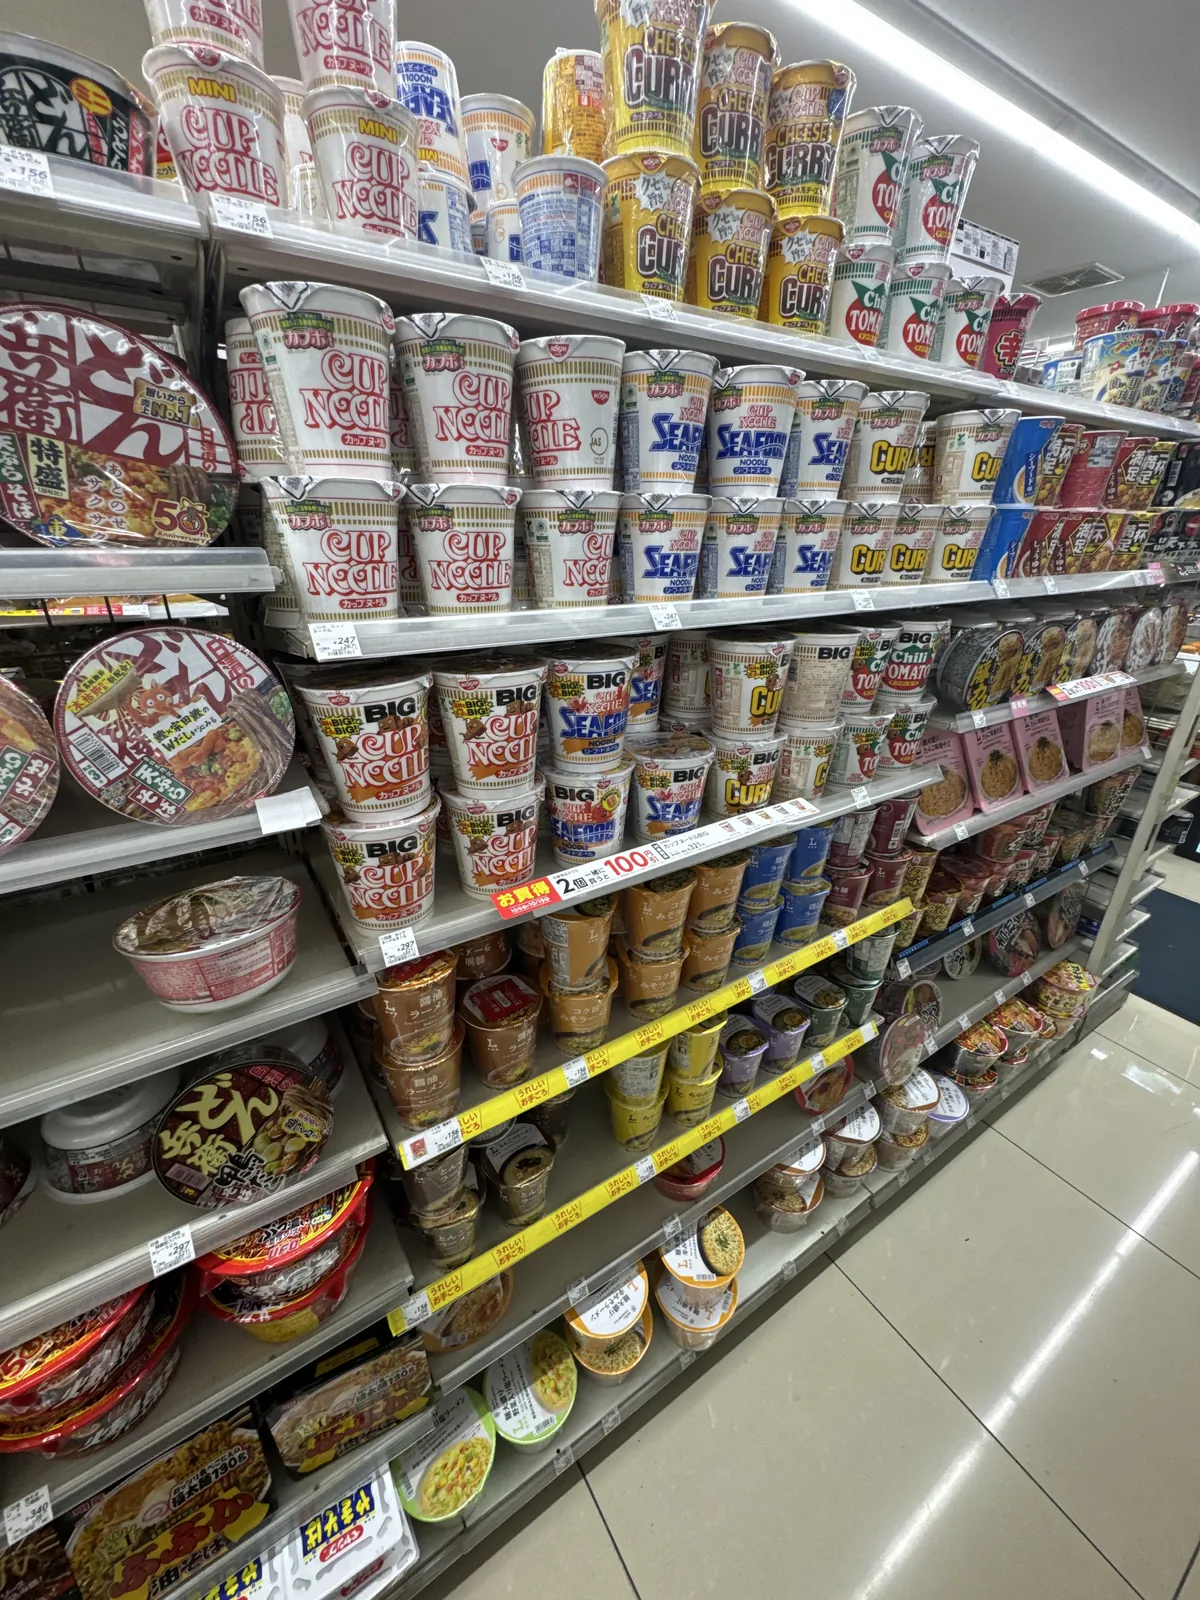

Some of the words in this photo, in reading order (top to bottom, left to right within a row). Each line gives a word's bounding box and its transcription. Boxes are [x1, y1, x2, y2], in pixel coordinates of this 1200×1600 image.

[187, 77, 236, 103] MINI
[180, 105, 260, 151] CUP
[358, 117, 398, 145] MINI
[346, 142, 411, 187] CUP
[764, 142, 836, 190] CURRY
[179, 149, 280, 206] NOODLE
[332, 180, 417, 236] NOODLE
[320, 350, 387, 394] CUP
[145, 386, 187, 405] 旨いから
[451, 371, 510, 409] CUP
[150, 403, 192, 425] No.1
[747, 405, 773, 418] CUP
[589, 436, 602, 447] JAS
[30, 436, 67, 494] 特盛
[739, 458, 769, 467] NOODLE
[5, 481, 38, 520] そば
[106, 460, 128, 531] あとのせ
[85, 476, 105, 542] サクサク
[320, 529, 392, 563] CUP
[443, 530, 506, 562] CUP
[303, 560, 398, 596] NOODLE
[428, 559, 512, 590] NOODLE
[341, 598, 388, 609] カップヌードル
[458, 592, 500, 603] カップヌードル
[898, 632, 933, 644] BIG
[818, 647, 850, 660] BIG
[892, 650, 929, 663] Chili
[586, 672, 627, 690] BIG
[495, 685, 538, 706] BIG
[364, 699, 418, 724] BIG
[486, 710, 539, 742] CUP
[356, 723, 422, 759] CUP
[133, 765, 188, 801] 天ぷら
[673, 767, 705, 783] BIG
[135, 786, 178, 819] そば
[555, 786, 595, 802] BIG
[496, 804, 536, 828] BIG
[366, 835, 419, 859] BIG
[485, 826, 537, 856] CUP
[359, 857, 425, 886] CUP
[604, 851, 649, 876] 100
[349, 877, 433, 911] NOODLE
[497, 880, 551, 908] お買得
[556, 875, 589, 895] 2個
[377, 907, 422, 922] カップヌードル
[410, 998, 450, 1020] ラーメン
[687, 999, 709, 1017] うれしい
[690, 1007, 712, 1022] お手ごろ
[635, 1024, 660, 1042] うれしい
[639, 1031, 663, 1048] お手ごろ
[406, 1080, 448, 1097] ラーメン
[517, 1079, 547, 1098] うれしい
[521, 1088, 549, 1107] お手ごろ
[608, 1171, 631, 1191] うれしい
[611, 1180, 634, 1199] お手ごろ
[554, 1204, 579, 1224] うれしい
[557, 1213, 582, 1231] お手ごろ
[496, 1238, 523, 1259] うれしい
[499, 1247, 525, 1268] お手ごろ
[430, 1273, 460, 1298] うれしい
[433, 1284, 462, 1307] お手ごろ
[301, 1488, 371, 1552] やきそば
[108, 1491, 256, 1598] ぶぶか
